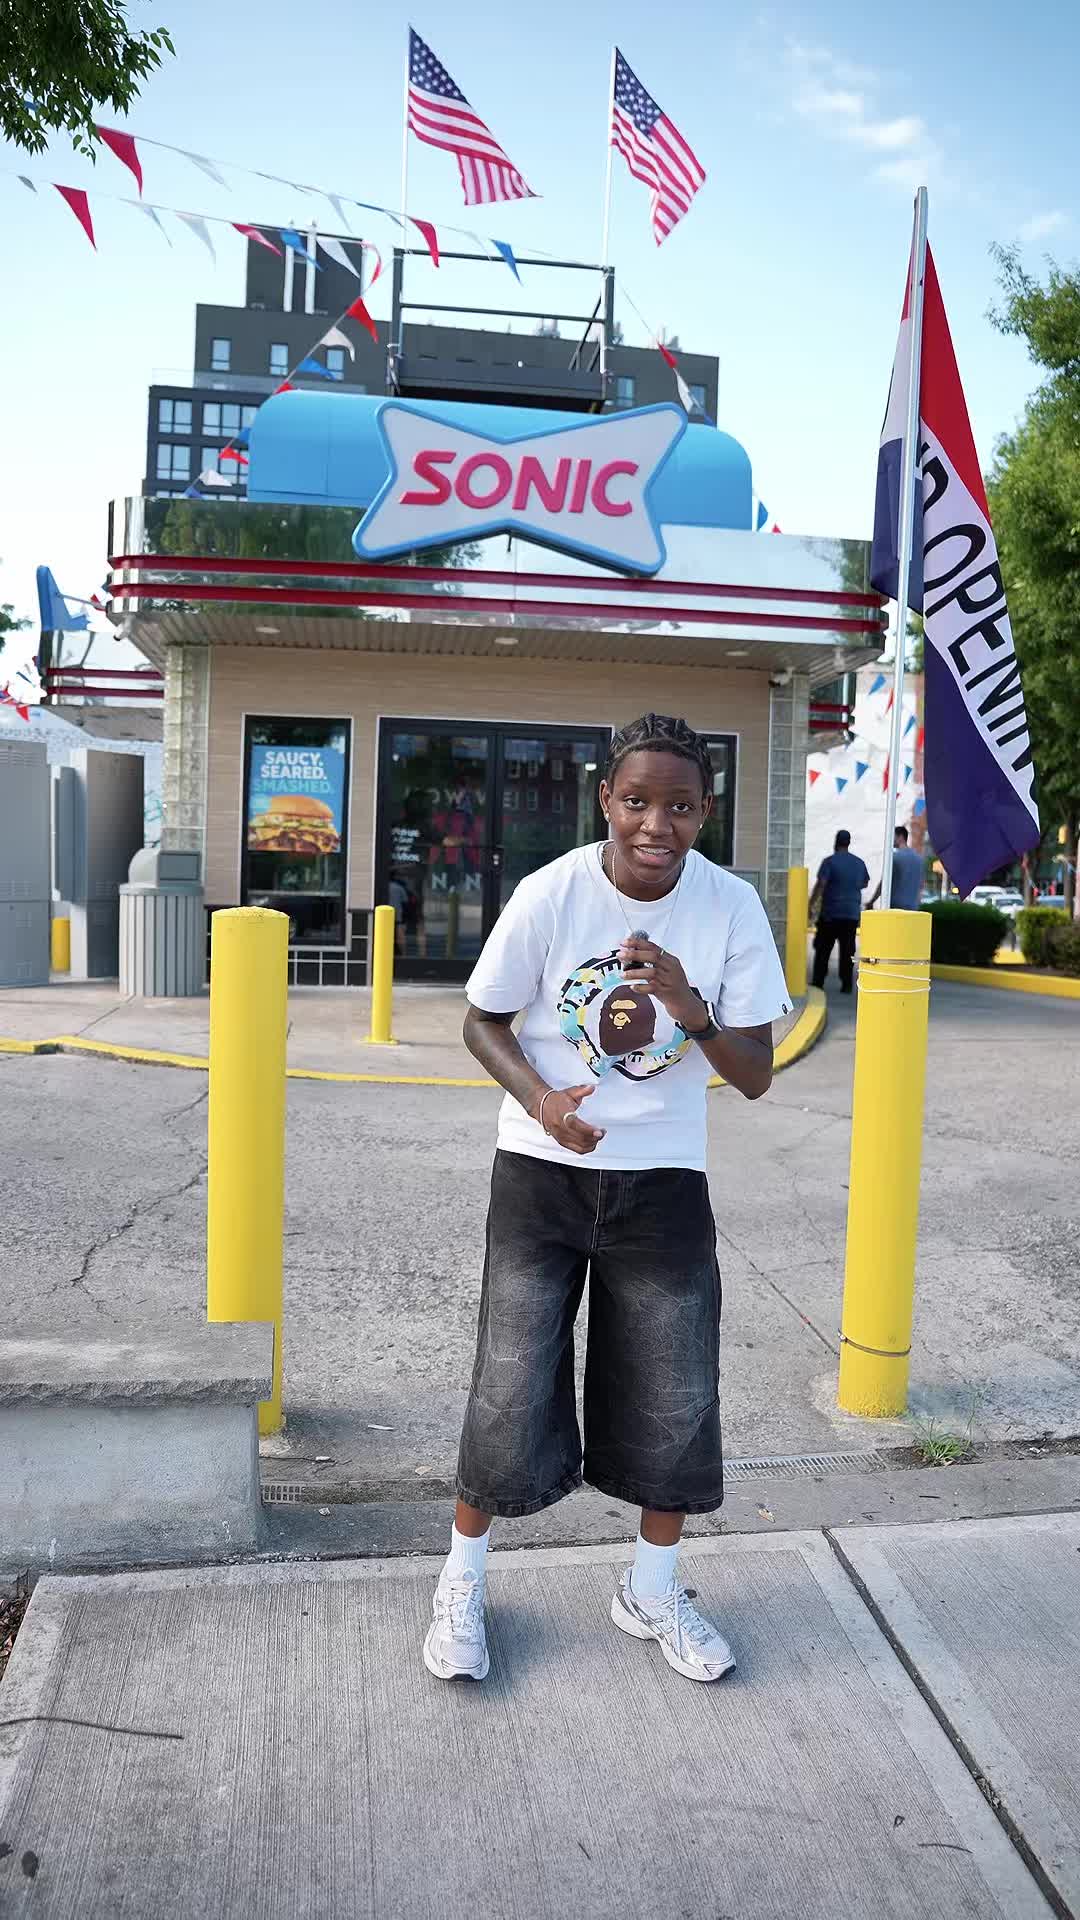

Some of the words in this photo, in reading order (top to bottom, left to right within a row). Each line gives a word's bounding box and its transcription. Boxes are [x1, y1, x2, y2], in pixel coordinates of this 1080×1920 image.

[400, 450, 639, 517] SONIC
[265, 751, 324, 767] SAUCY.
[261, 765, 328, 780] SEARED.
